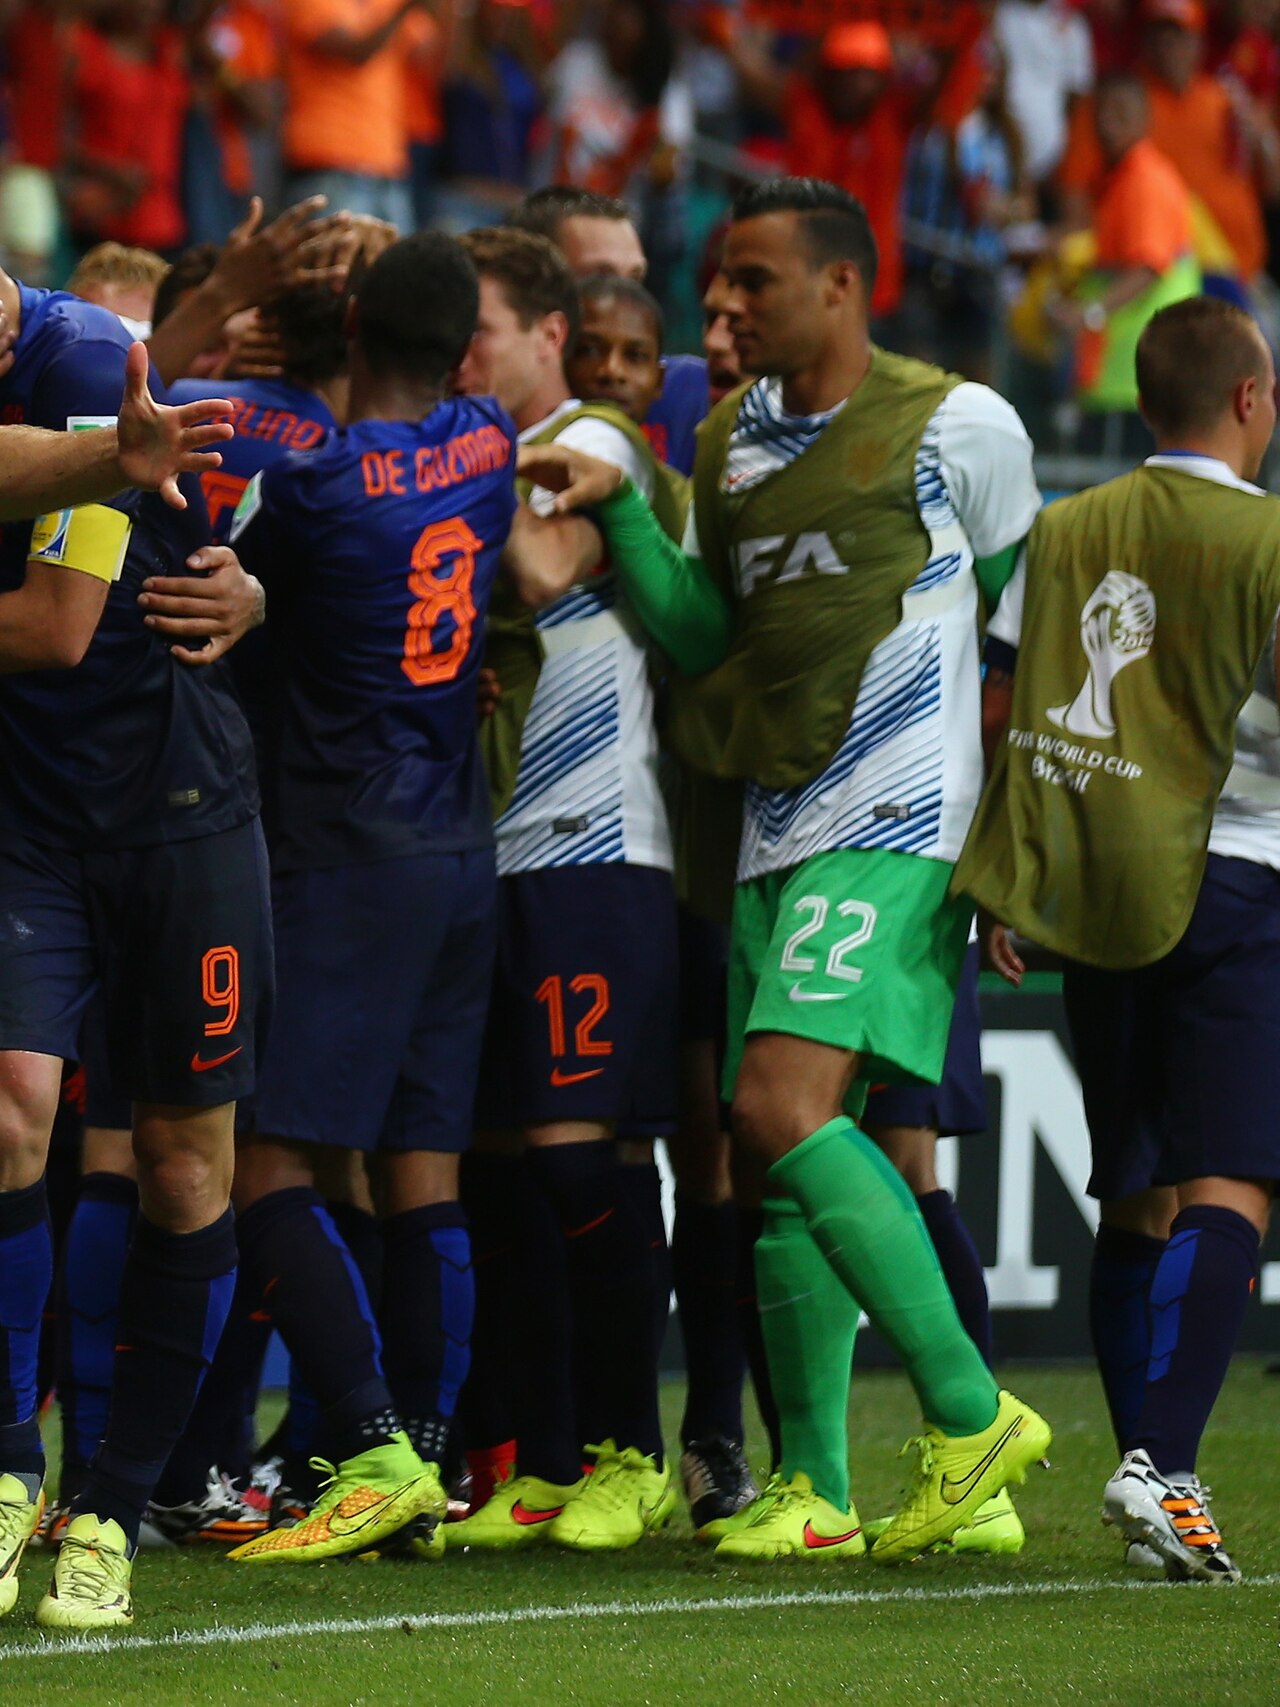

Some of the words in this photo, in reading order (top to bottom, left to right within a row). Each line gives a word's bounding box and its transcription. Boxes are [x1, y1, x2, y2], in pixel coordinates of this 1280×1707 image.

[361, 449, 407, 496] DE
[414, 424, 510, 493] GUZMAN
[400, 516, 485, 686] 8
[1036, 732, 1104, 769] WORLD
[1104, 755, 1144, 781] CUP
[780, 895, 878, 983] 22
[202, 945, 240, 1036] 9
[534, 973, 614, 1057] 12
